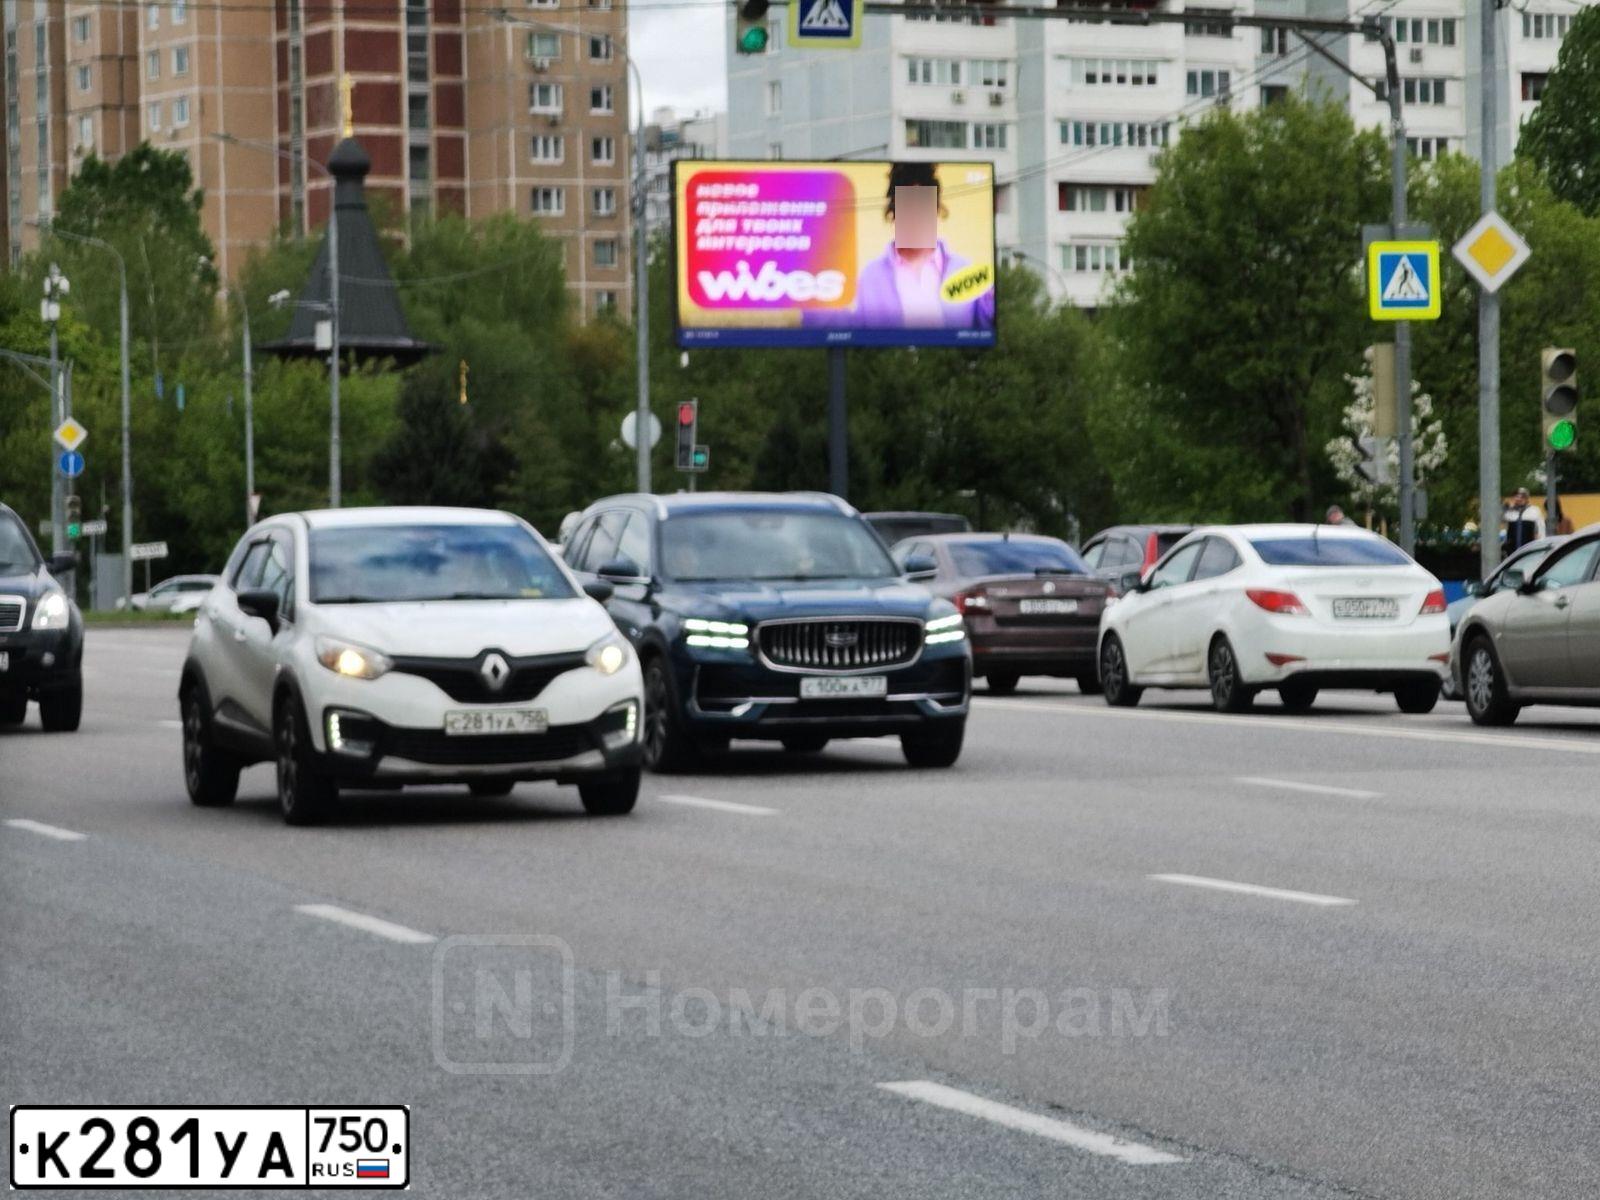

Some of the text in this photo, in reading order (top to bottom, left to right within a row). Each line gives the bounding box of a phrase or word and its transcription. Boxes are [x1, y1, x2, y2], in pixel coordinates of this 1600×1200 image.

[696, 183, 759, 198] новое
[696, 201, 827, 219] приложение
[695, 218, 804, 235] для твоих
[696, 235, 811, 254] интересов
